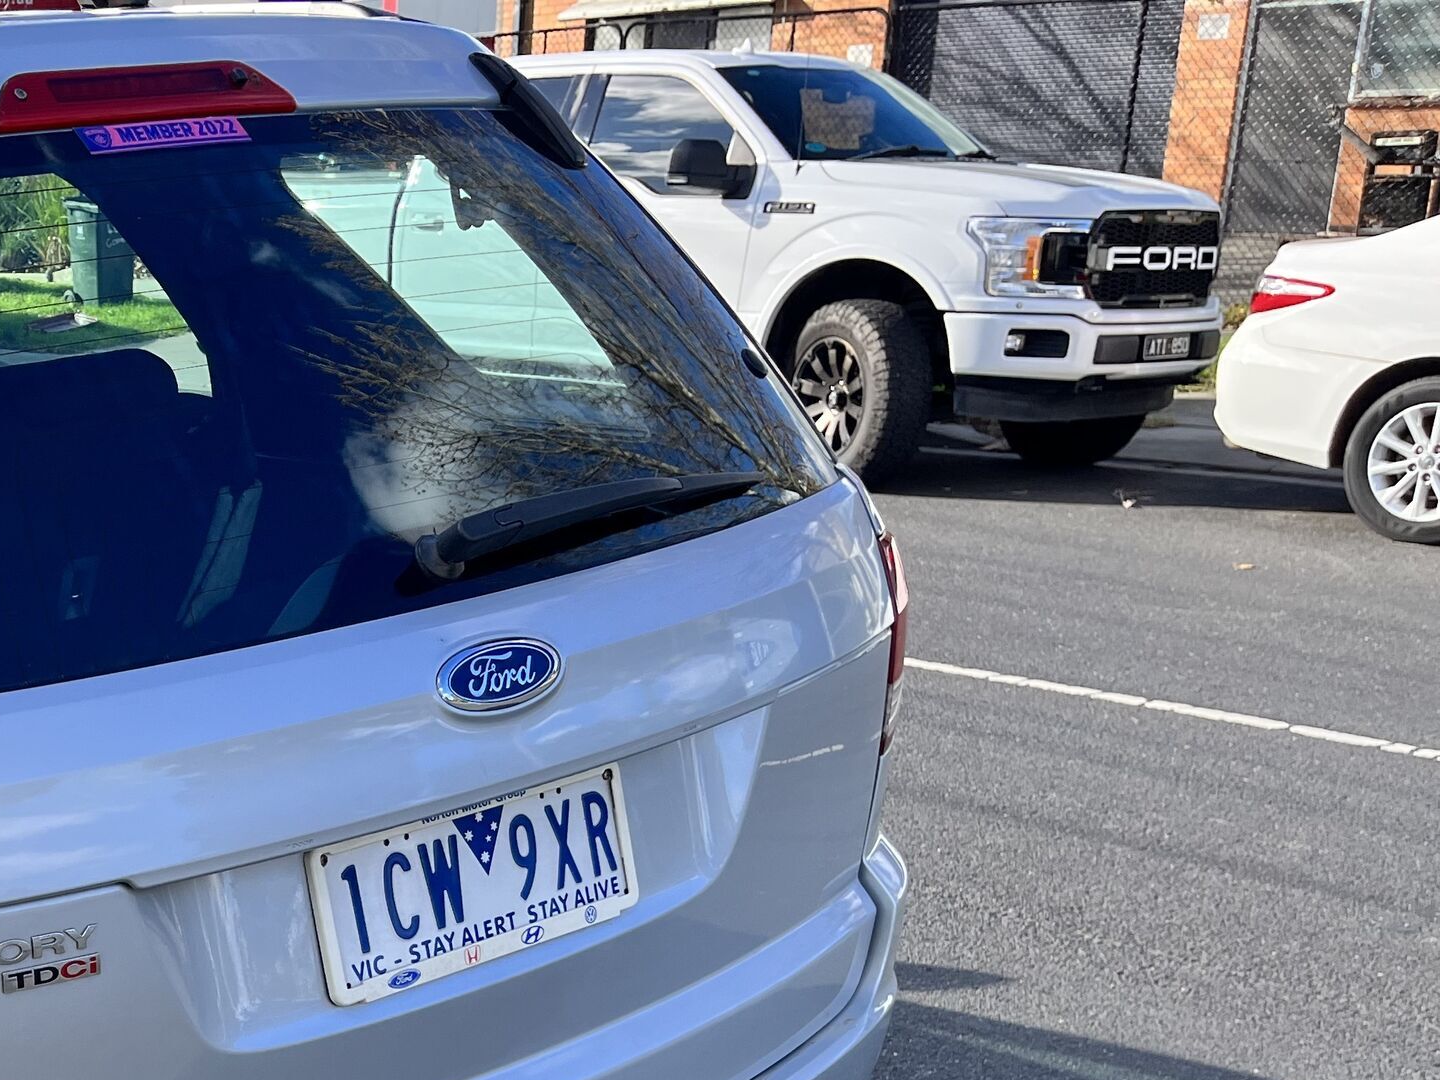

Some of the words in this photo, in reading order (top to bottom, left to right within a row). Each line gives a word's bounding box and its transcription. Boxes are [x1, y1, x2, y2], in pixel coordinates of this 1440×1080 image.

[115, 122, 195, 143] MEMBER
[193, 119, 238, 136] 2022
[1106, 246, 1218, 271] FORD
[468, 651, 536, 698] Ford
[422, 808, 459, 824] Norton
[462, 800, 491, 812] Motor
[495, 789, 527, 802] Group
[341, 834, 464, 954] 1CW
[510, 791, 618, 900] 9XR
[352, 955, 387, 982] VIC
[409, 931, 456, 964] STAY
[462, 912, 516, 947] ALERT
[528, 893, 569, 924] STAY
[574, 876, 621, 909] ALIVE
[7, 956, 98, 990] TDCi
